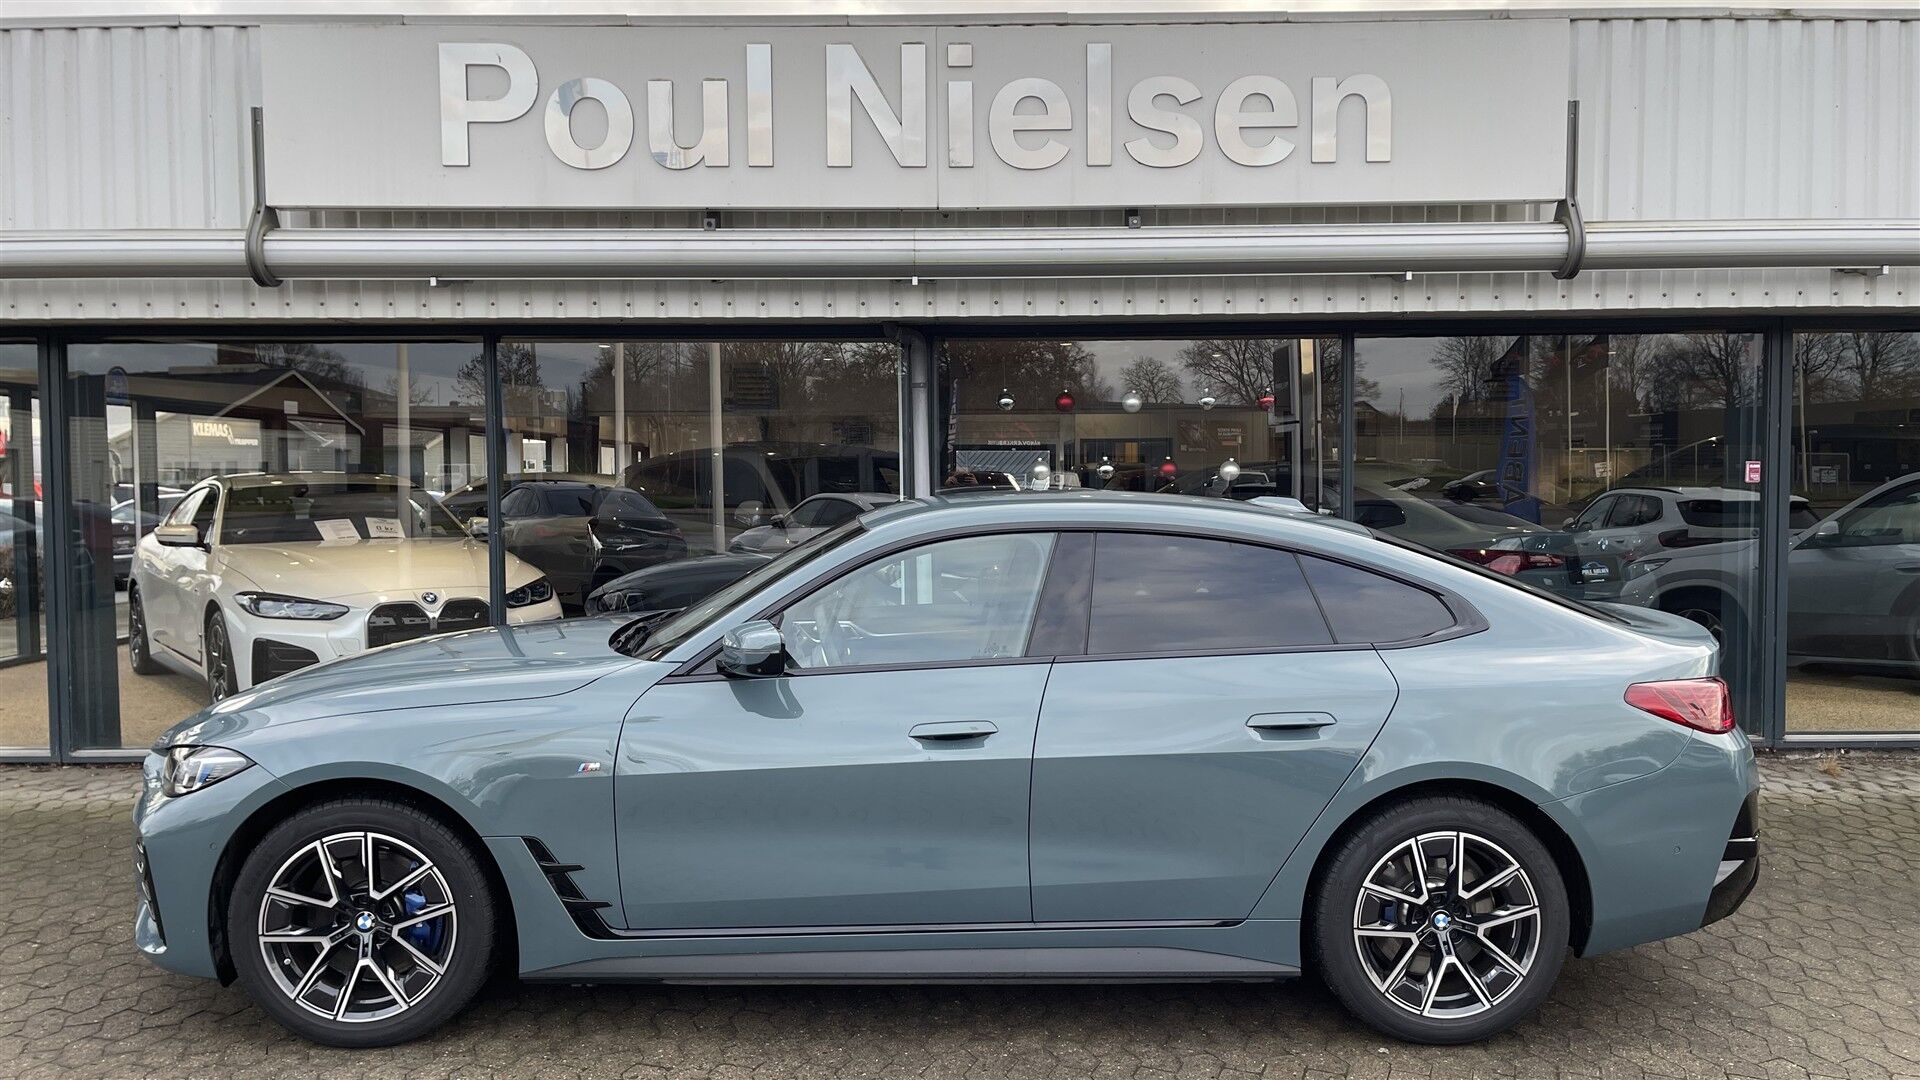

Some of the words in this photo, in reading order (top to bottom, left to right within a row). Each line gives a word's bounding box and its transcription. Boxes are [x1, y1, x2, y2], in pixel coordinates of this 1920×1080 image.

[438, 43, 774, 169] Poul
[826, 42, 1393, 169] Nielsen
[193, 422, 228, 438] KLEMAS
